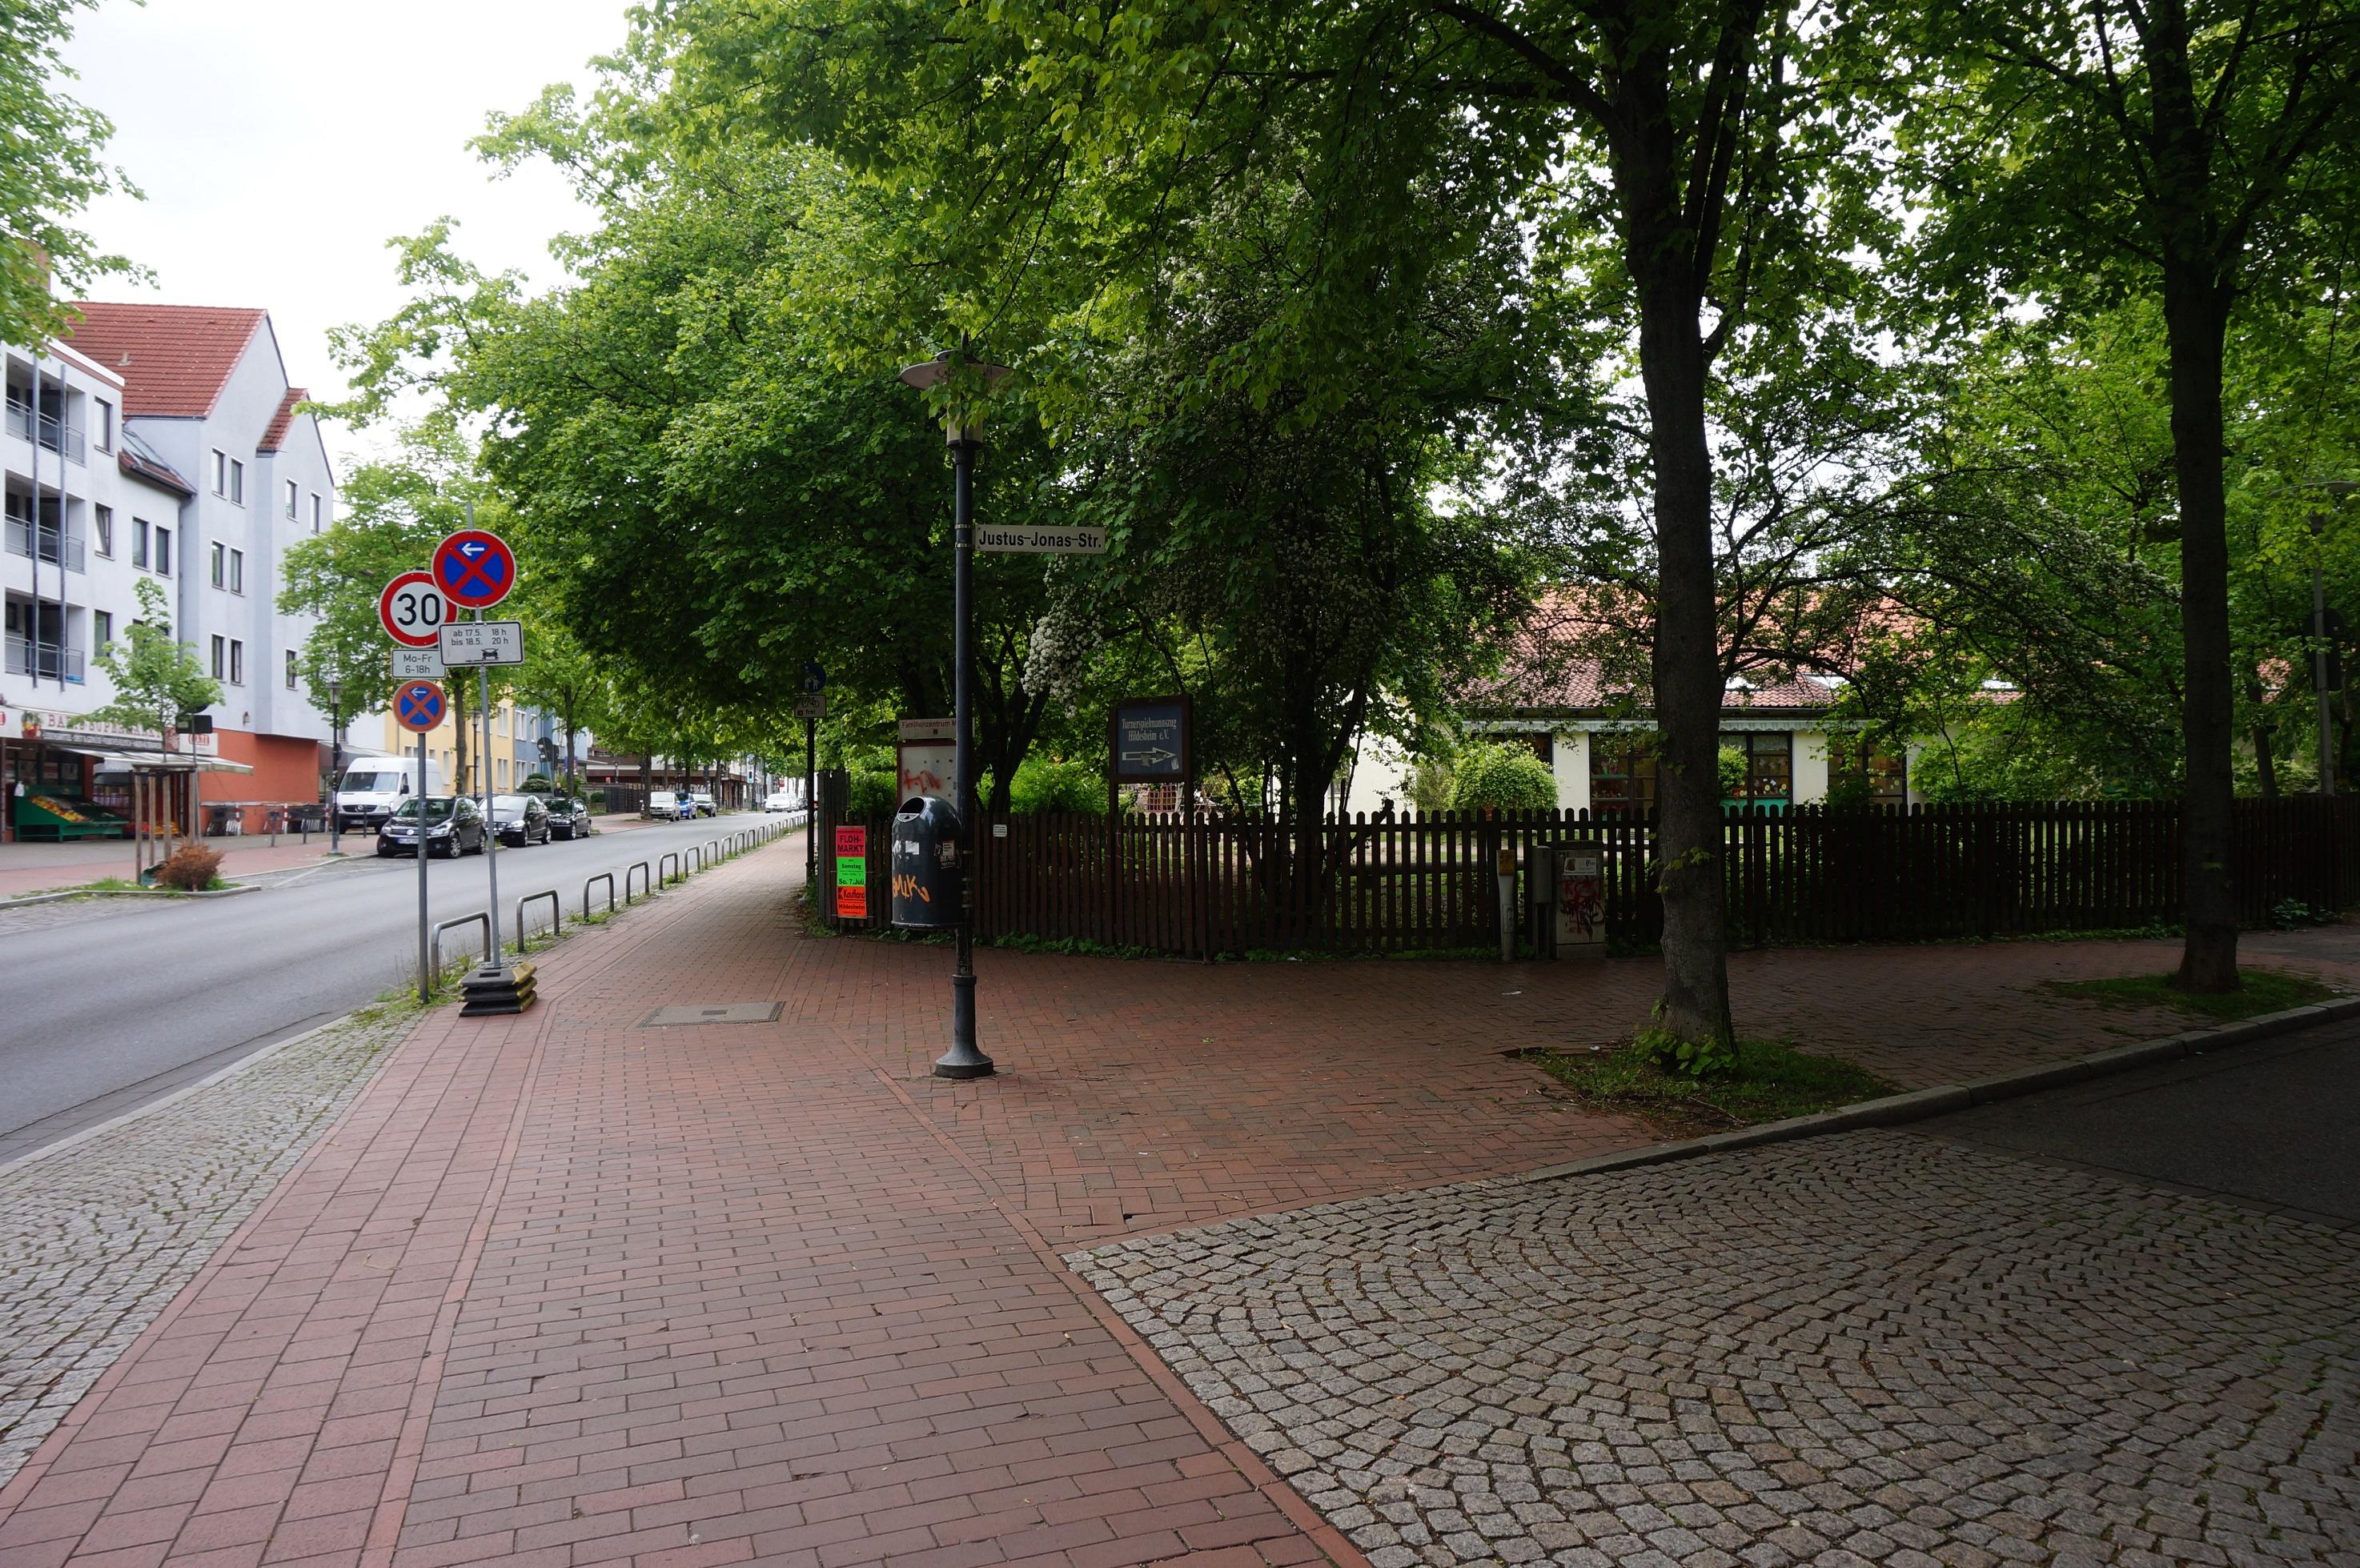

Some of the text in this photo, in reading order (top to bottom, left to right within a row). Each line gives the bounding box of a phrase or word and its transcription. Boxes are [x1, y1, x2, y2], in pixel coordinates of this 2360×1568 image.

[979, 530, 1102, 548] Justus-Jonas-Str.
[397, 593, 440, 626] 30
[452, 629, 464, 637] ab
[465, 628, 483, 637] 17.5.
[492, 628, 500, 636] 18
[466, 638, 483, 646] 18.5.
[492, 637, 502, 645] 20
[403, 654, 432, 663] Mo-Fr
[405, 665, 431, 674] 6-18h
[1128, 729, 1158, 741] Hildesheim
[840, 835, 861, 843] FLOH-
[837, 844, 864, 852] MARKT
